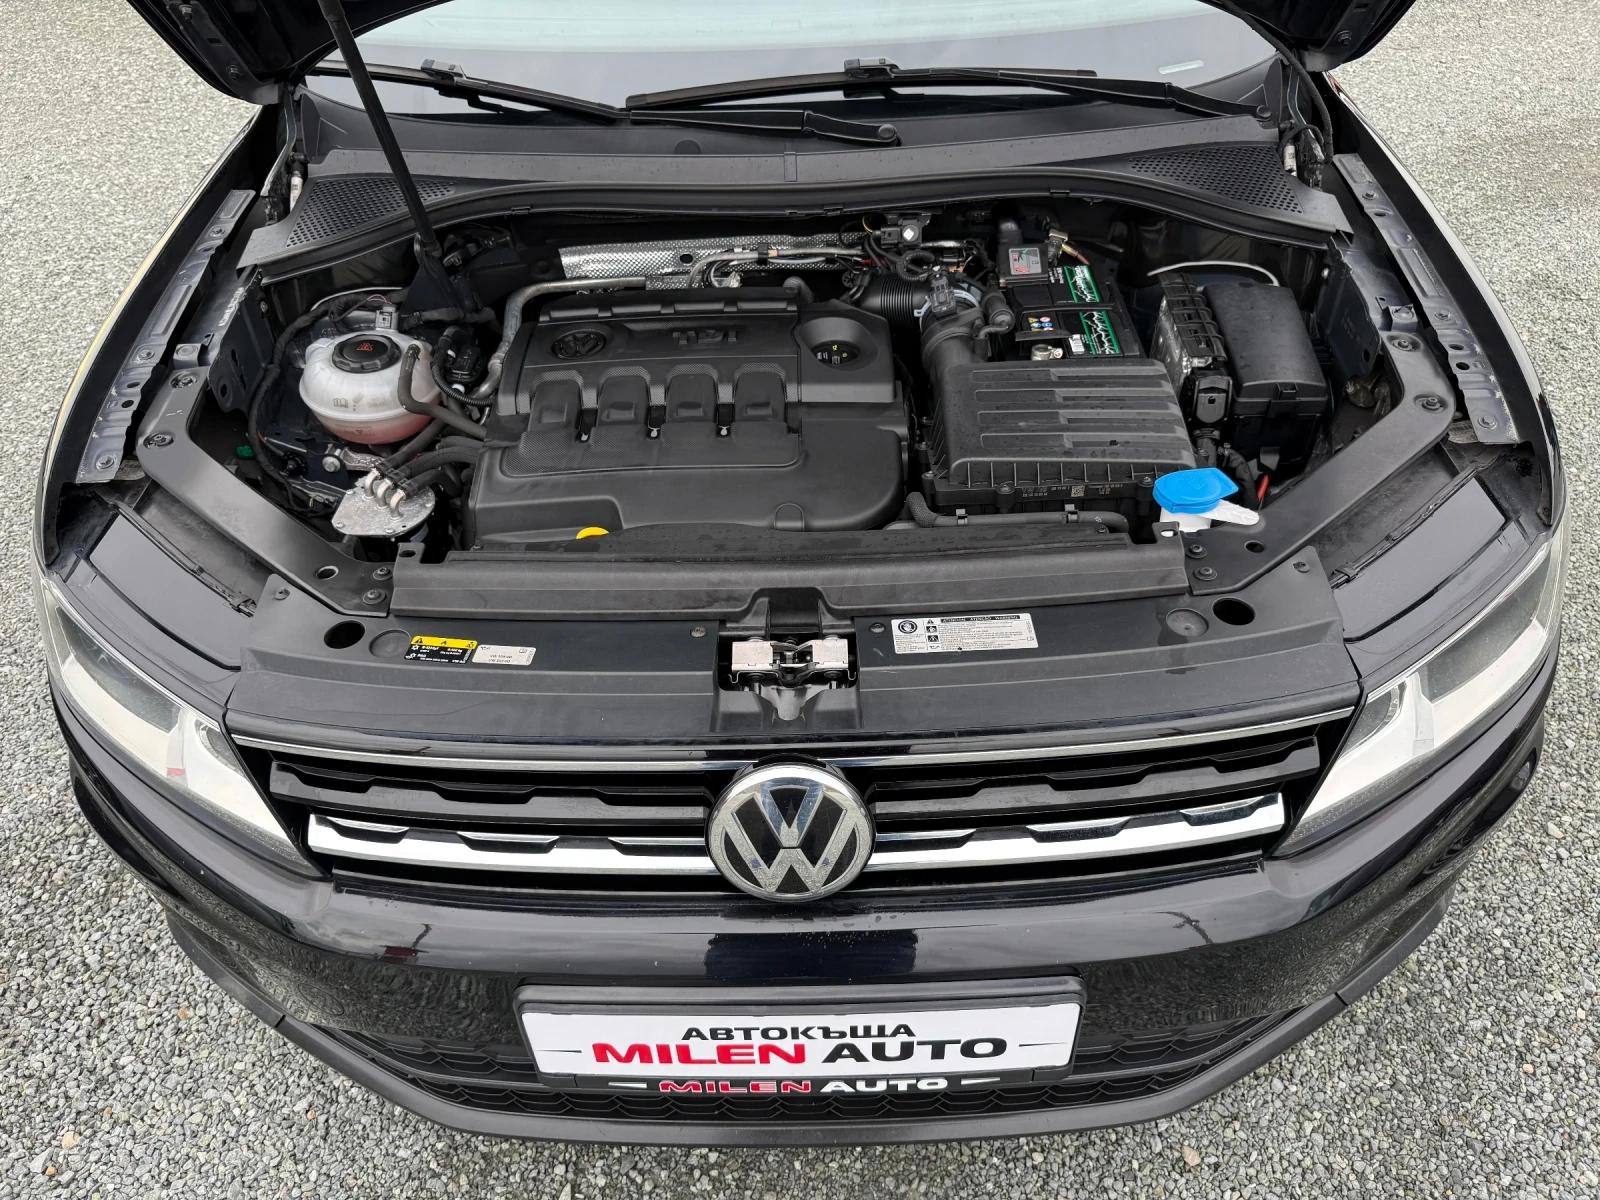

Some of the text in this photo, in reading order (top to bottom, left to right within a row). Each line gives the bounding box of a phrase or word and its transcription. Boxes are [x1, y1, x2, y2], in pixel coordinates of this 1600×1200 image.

[682, 1023, 916, 1041] АВТОКЪША
[592, 1037, 1008, 1065] MILEN AUTO
[659, 1078, 948, 1093] MILEN AUTO
